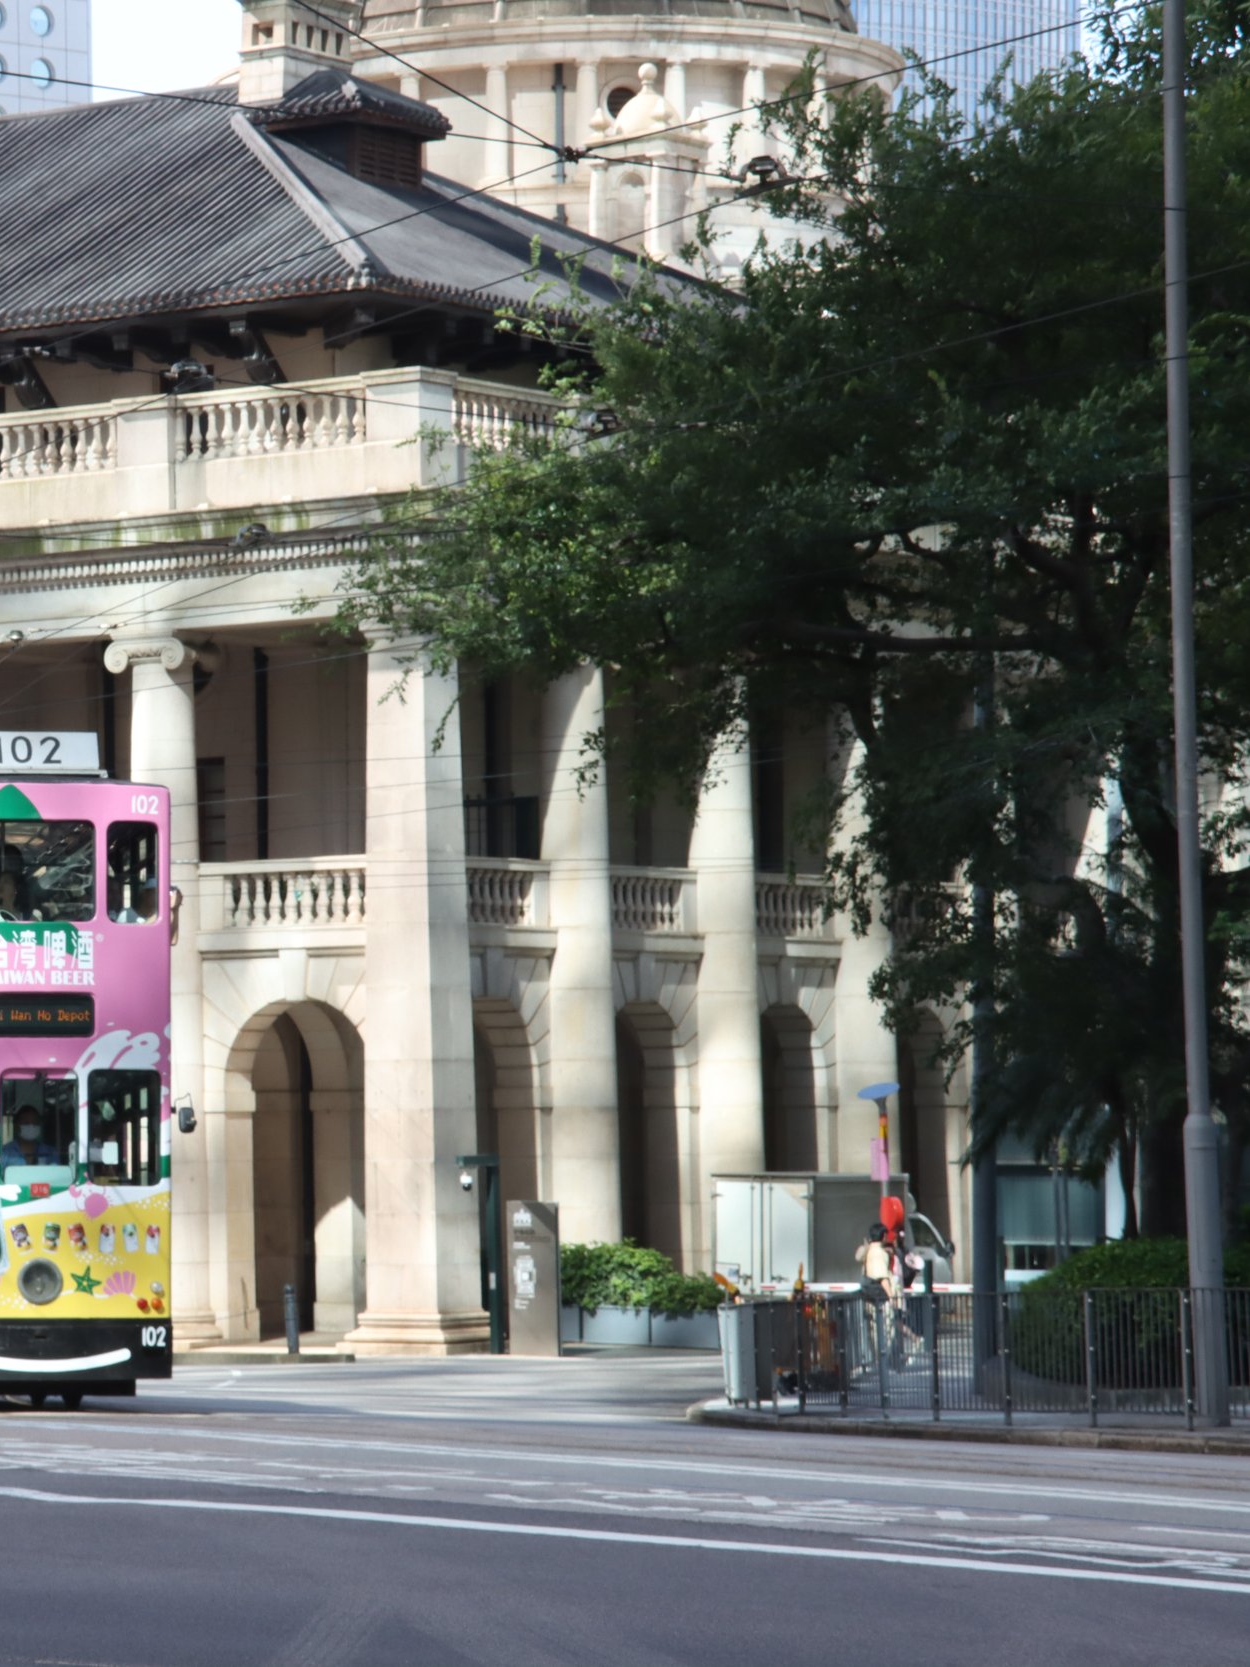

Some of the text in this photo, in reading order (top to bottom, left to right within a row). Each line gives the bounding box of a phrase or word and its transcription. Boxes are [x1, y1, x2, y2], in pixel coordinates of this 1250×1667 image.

[131, 795, 159, 815] 102
[50, 970, 95, 986] BEER
[11, 1009, 31, 1021] Wan
[38, 1009, 51, 1021] Ho
[58, 1009, 90, 1023] Depot
[141, 1325, 167, 1348] 102
